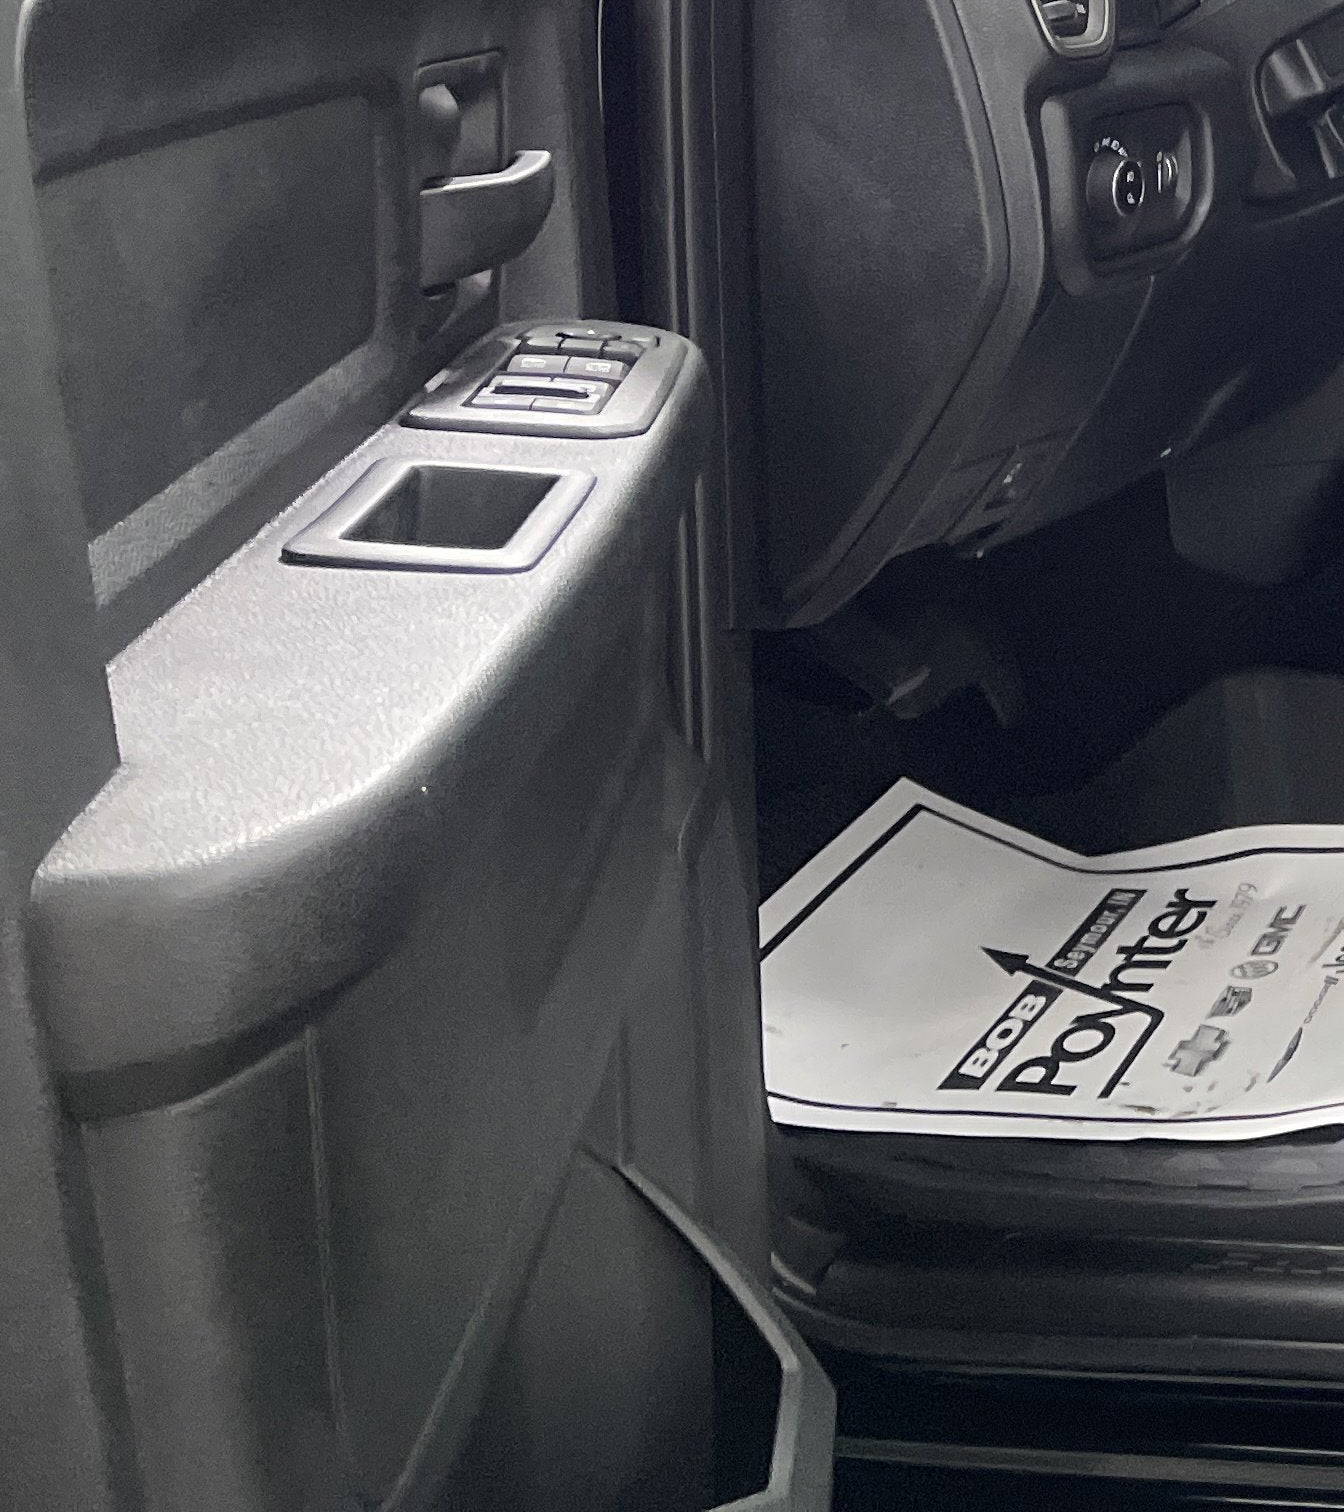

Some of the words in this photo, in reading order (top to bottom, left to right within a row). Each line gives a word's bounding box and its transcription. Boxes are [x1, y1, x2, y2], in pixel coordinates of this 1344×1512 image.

[1251, 904, 1307, 956] GMC
[958, 993, 1047, 1079] BOB
[995, 888, 1218, 1099] Poynter
